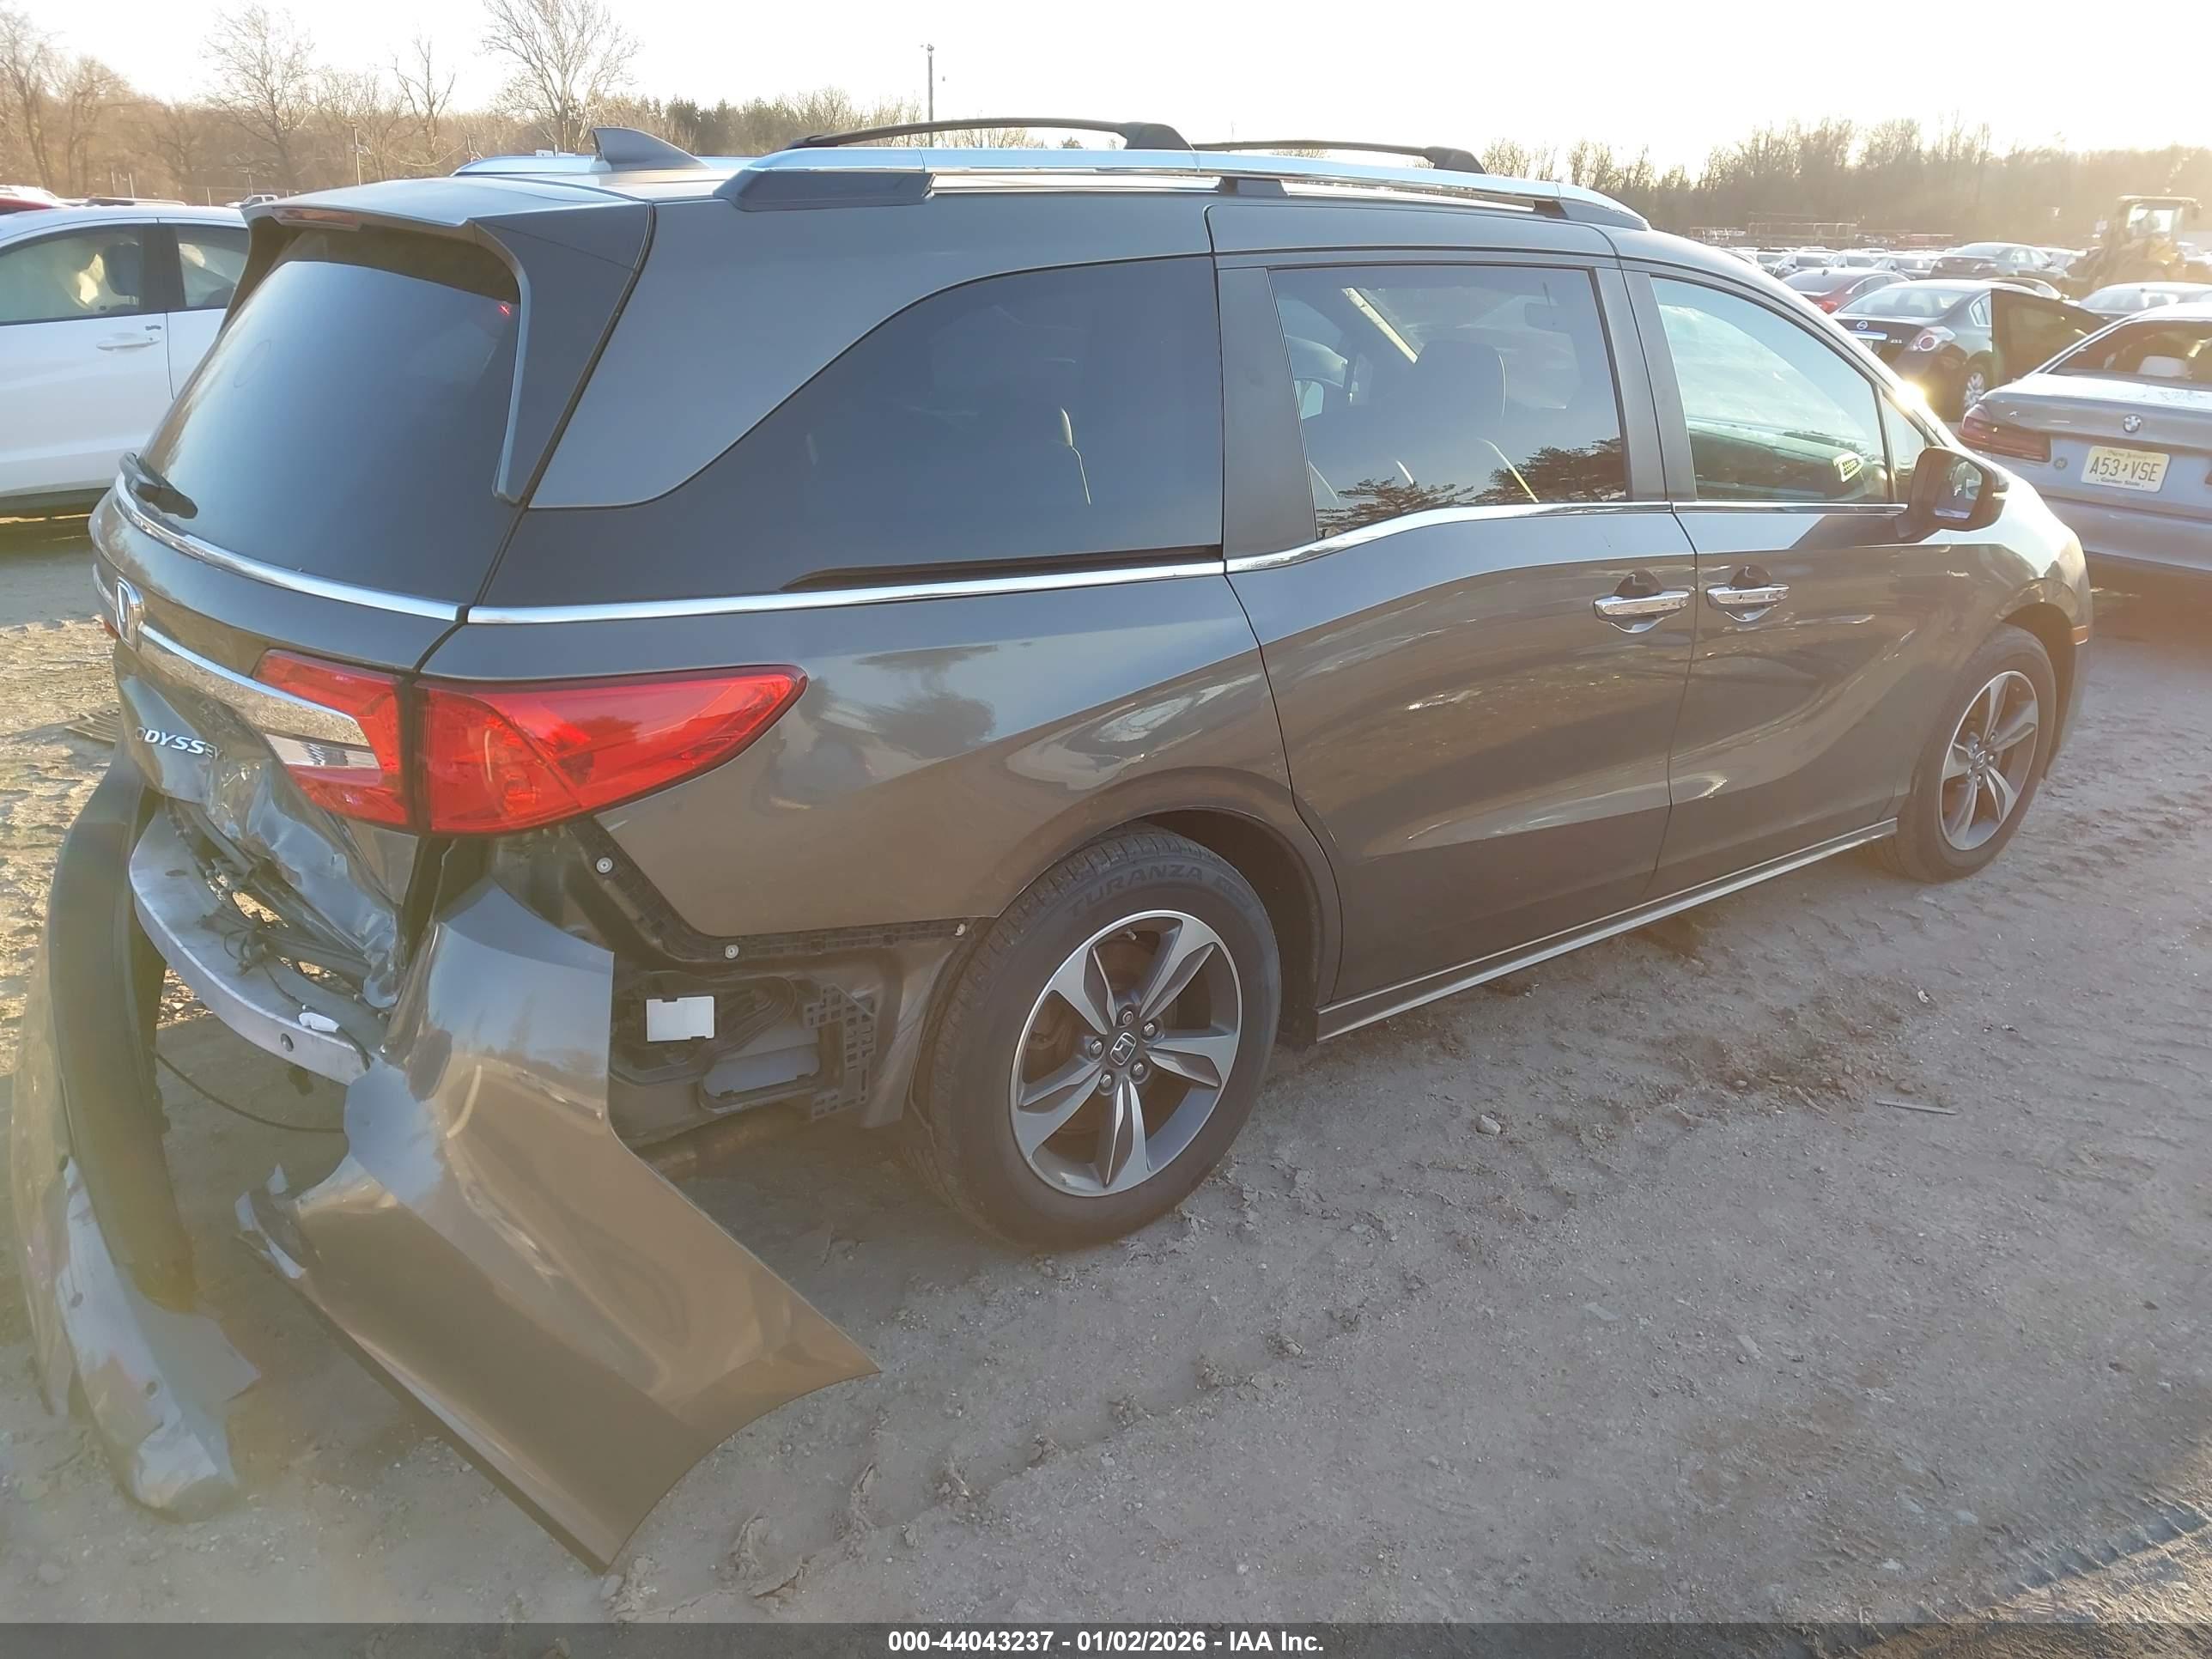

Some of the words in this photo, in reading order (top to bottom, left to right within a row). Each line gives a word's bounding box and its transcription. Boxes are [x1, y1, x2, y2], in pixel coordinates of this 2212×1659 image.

[2089, 456, 2121, 477] A53
[2130, 460, 2162, 483] VSE
[1066, 864, 1204, 916] TURANZA
